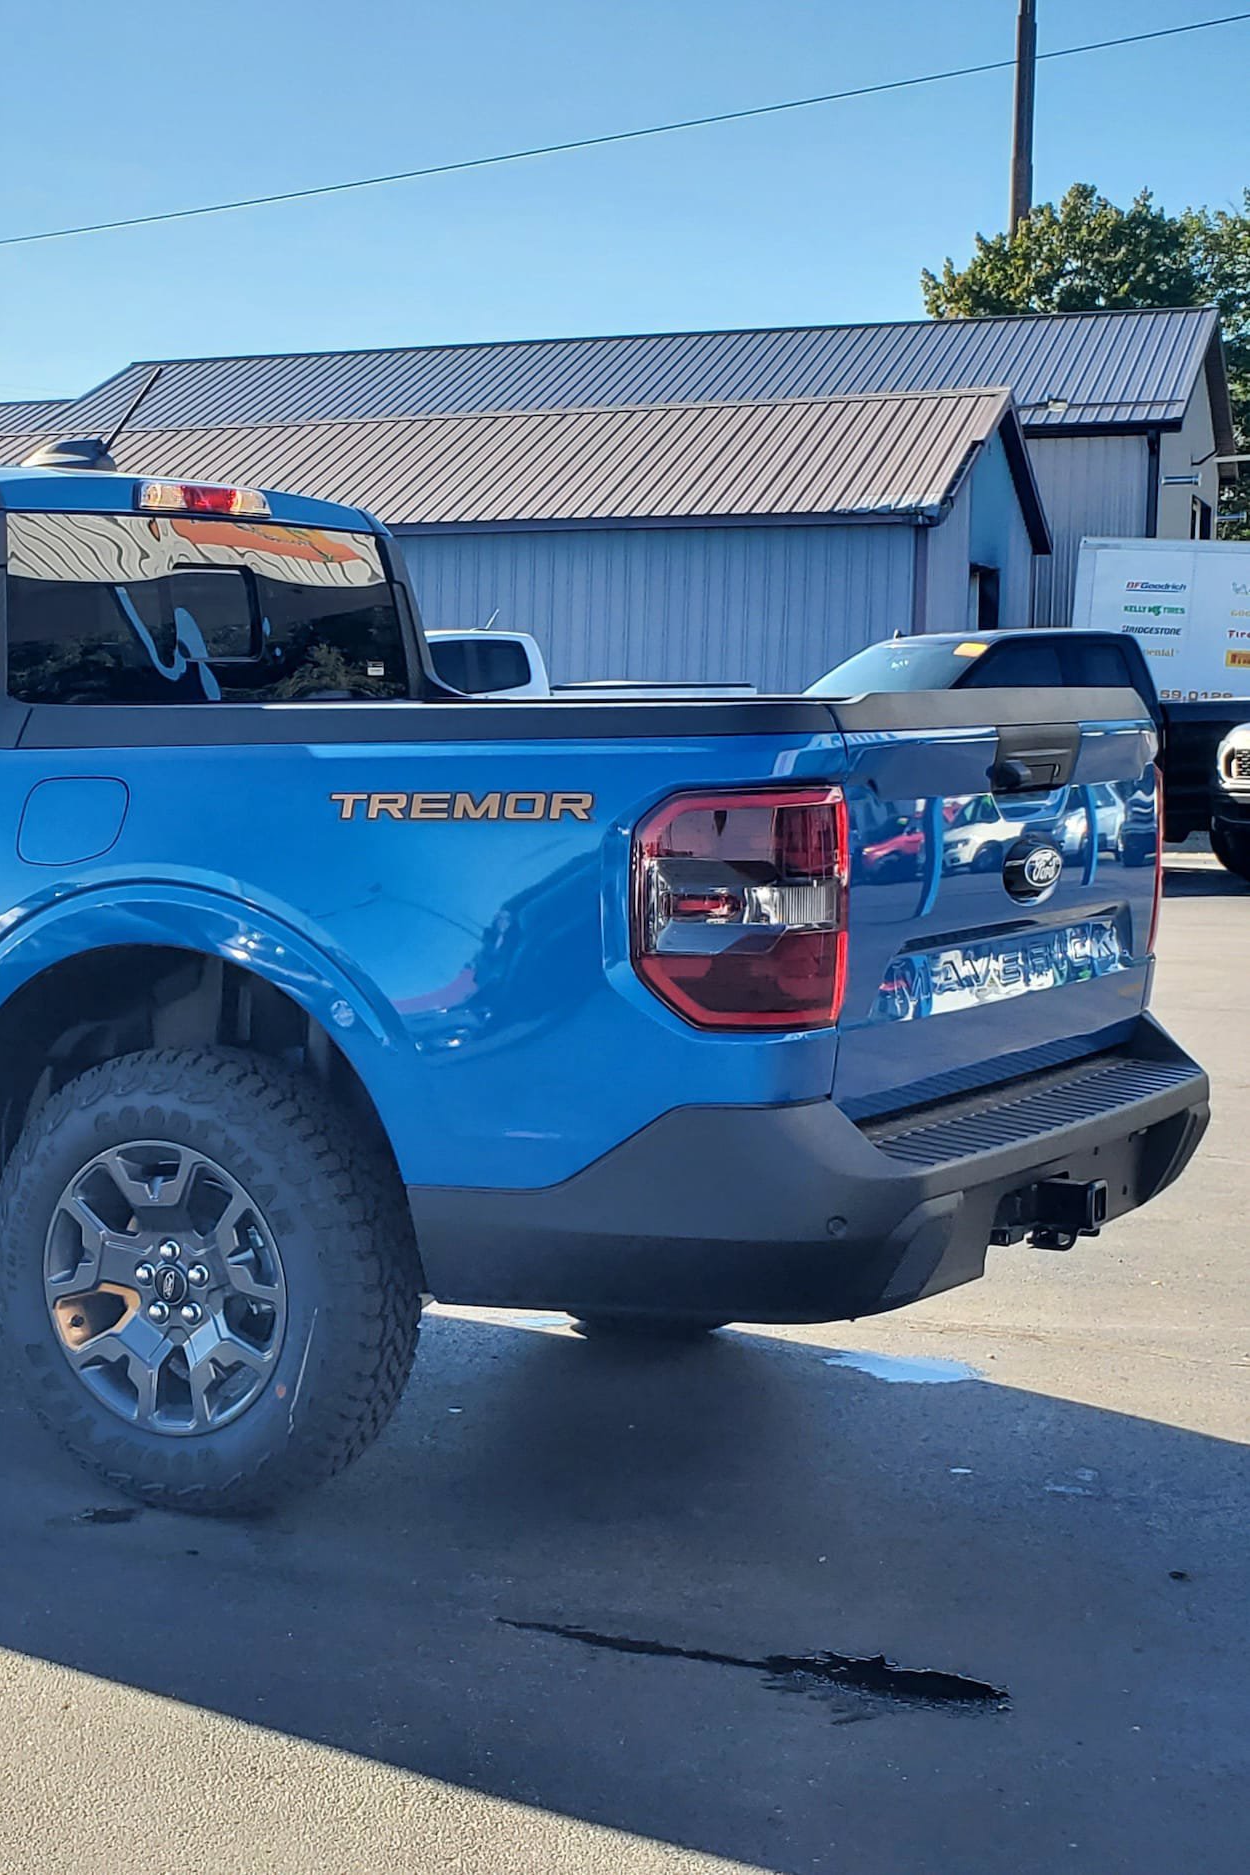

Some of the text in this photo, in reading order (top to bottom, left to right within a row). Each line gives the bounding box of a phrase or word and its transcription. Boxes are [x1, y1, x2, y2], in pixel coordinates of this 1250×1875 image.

[1123, 605, 1147, 613] KELLY
[1121, 624, 1182, 636] BRIDGESTONE
[330, 791, 595, 820] TREMOR
[1028, 850, 1061, 884] Ford
[893, 922, 1118, 1004] MAVERICK
